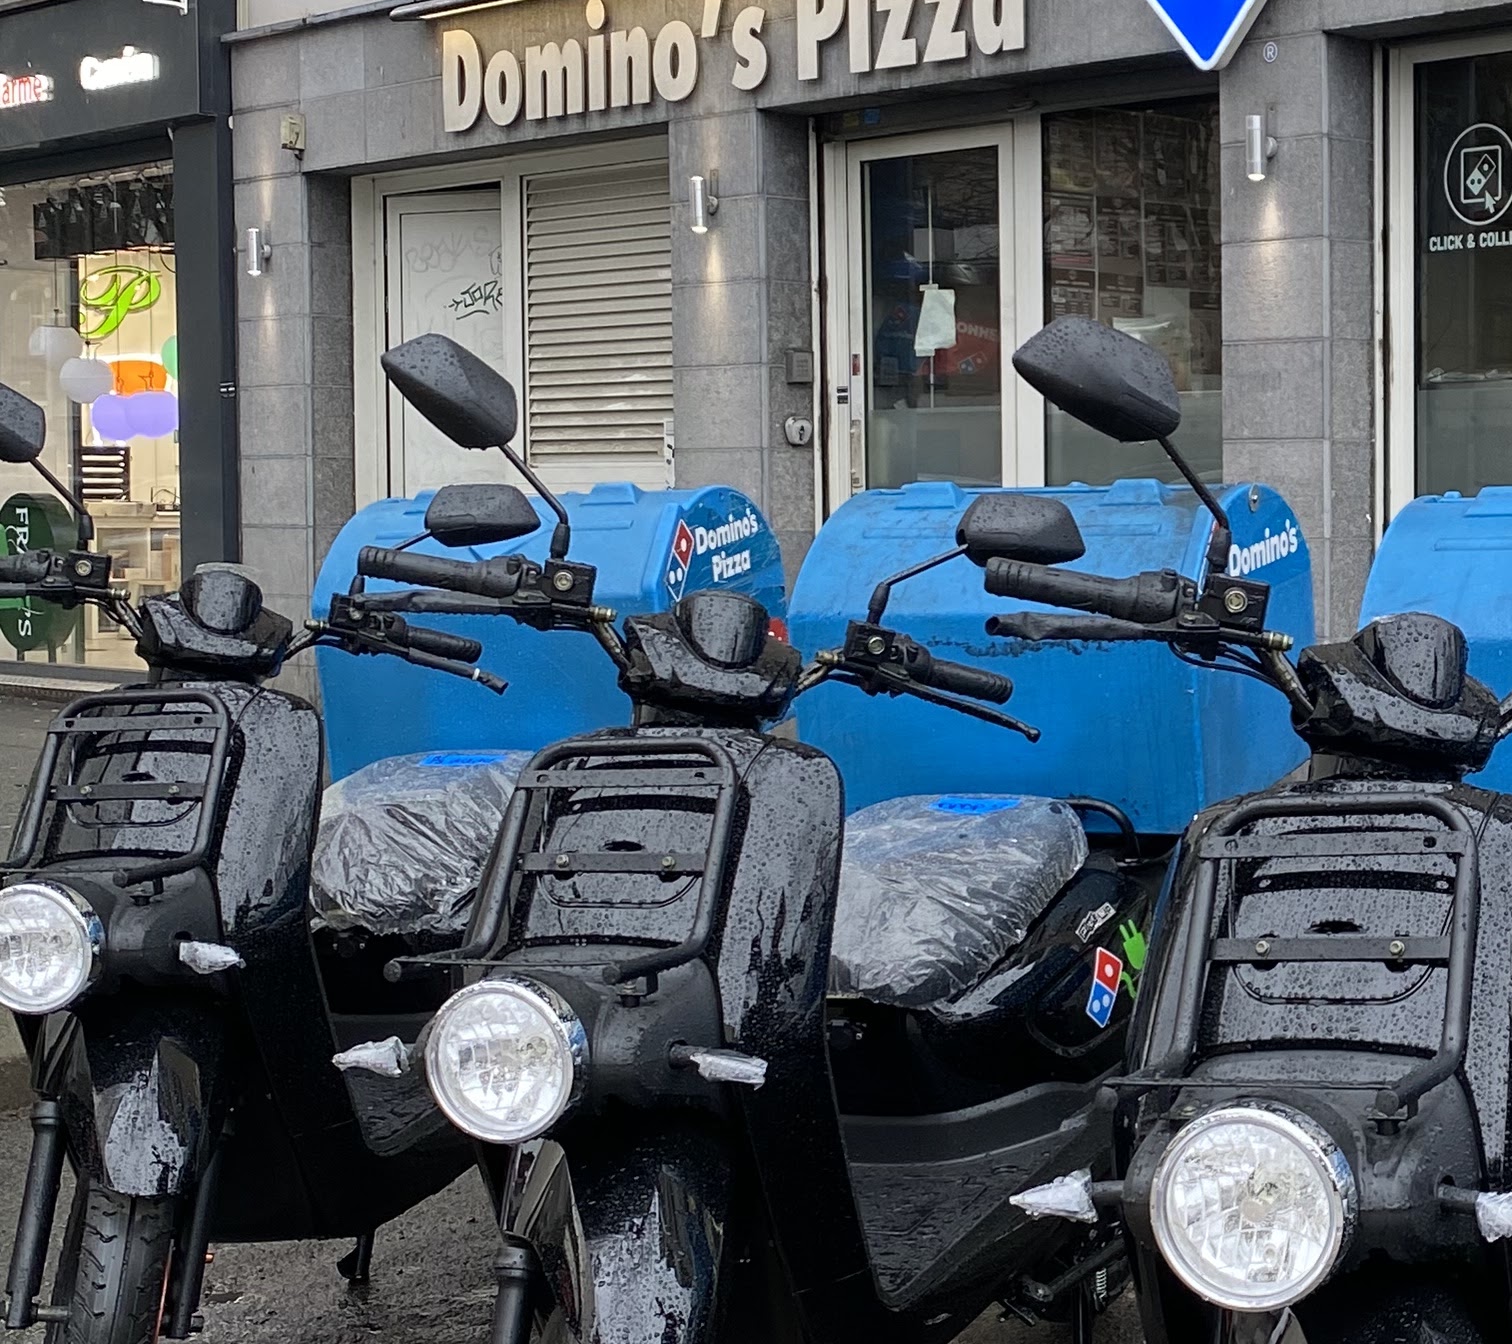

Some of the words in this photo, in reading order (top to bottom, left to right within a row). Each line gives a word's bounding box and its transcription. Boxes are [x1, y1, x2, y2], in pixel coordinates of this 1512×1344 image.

[1429, 235, 1463, 252] CLICK
[1467, 233, 1476, 249] &
[694, 508, 759, 556] Domino's
[1228, 518, 1299, 577] Domino's
[711, 550, 752, 583] Pizza
